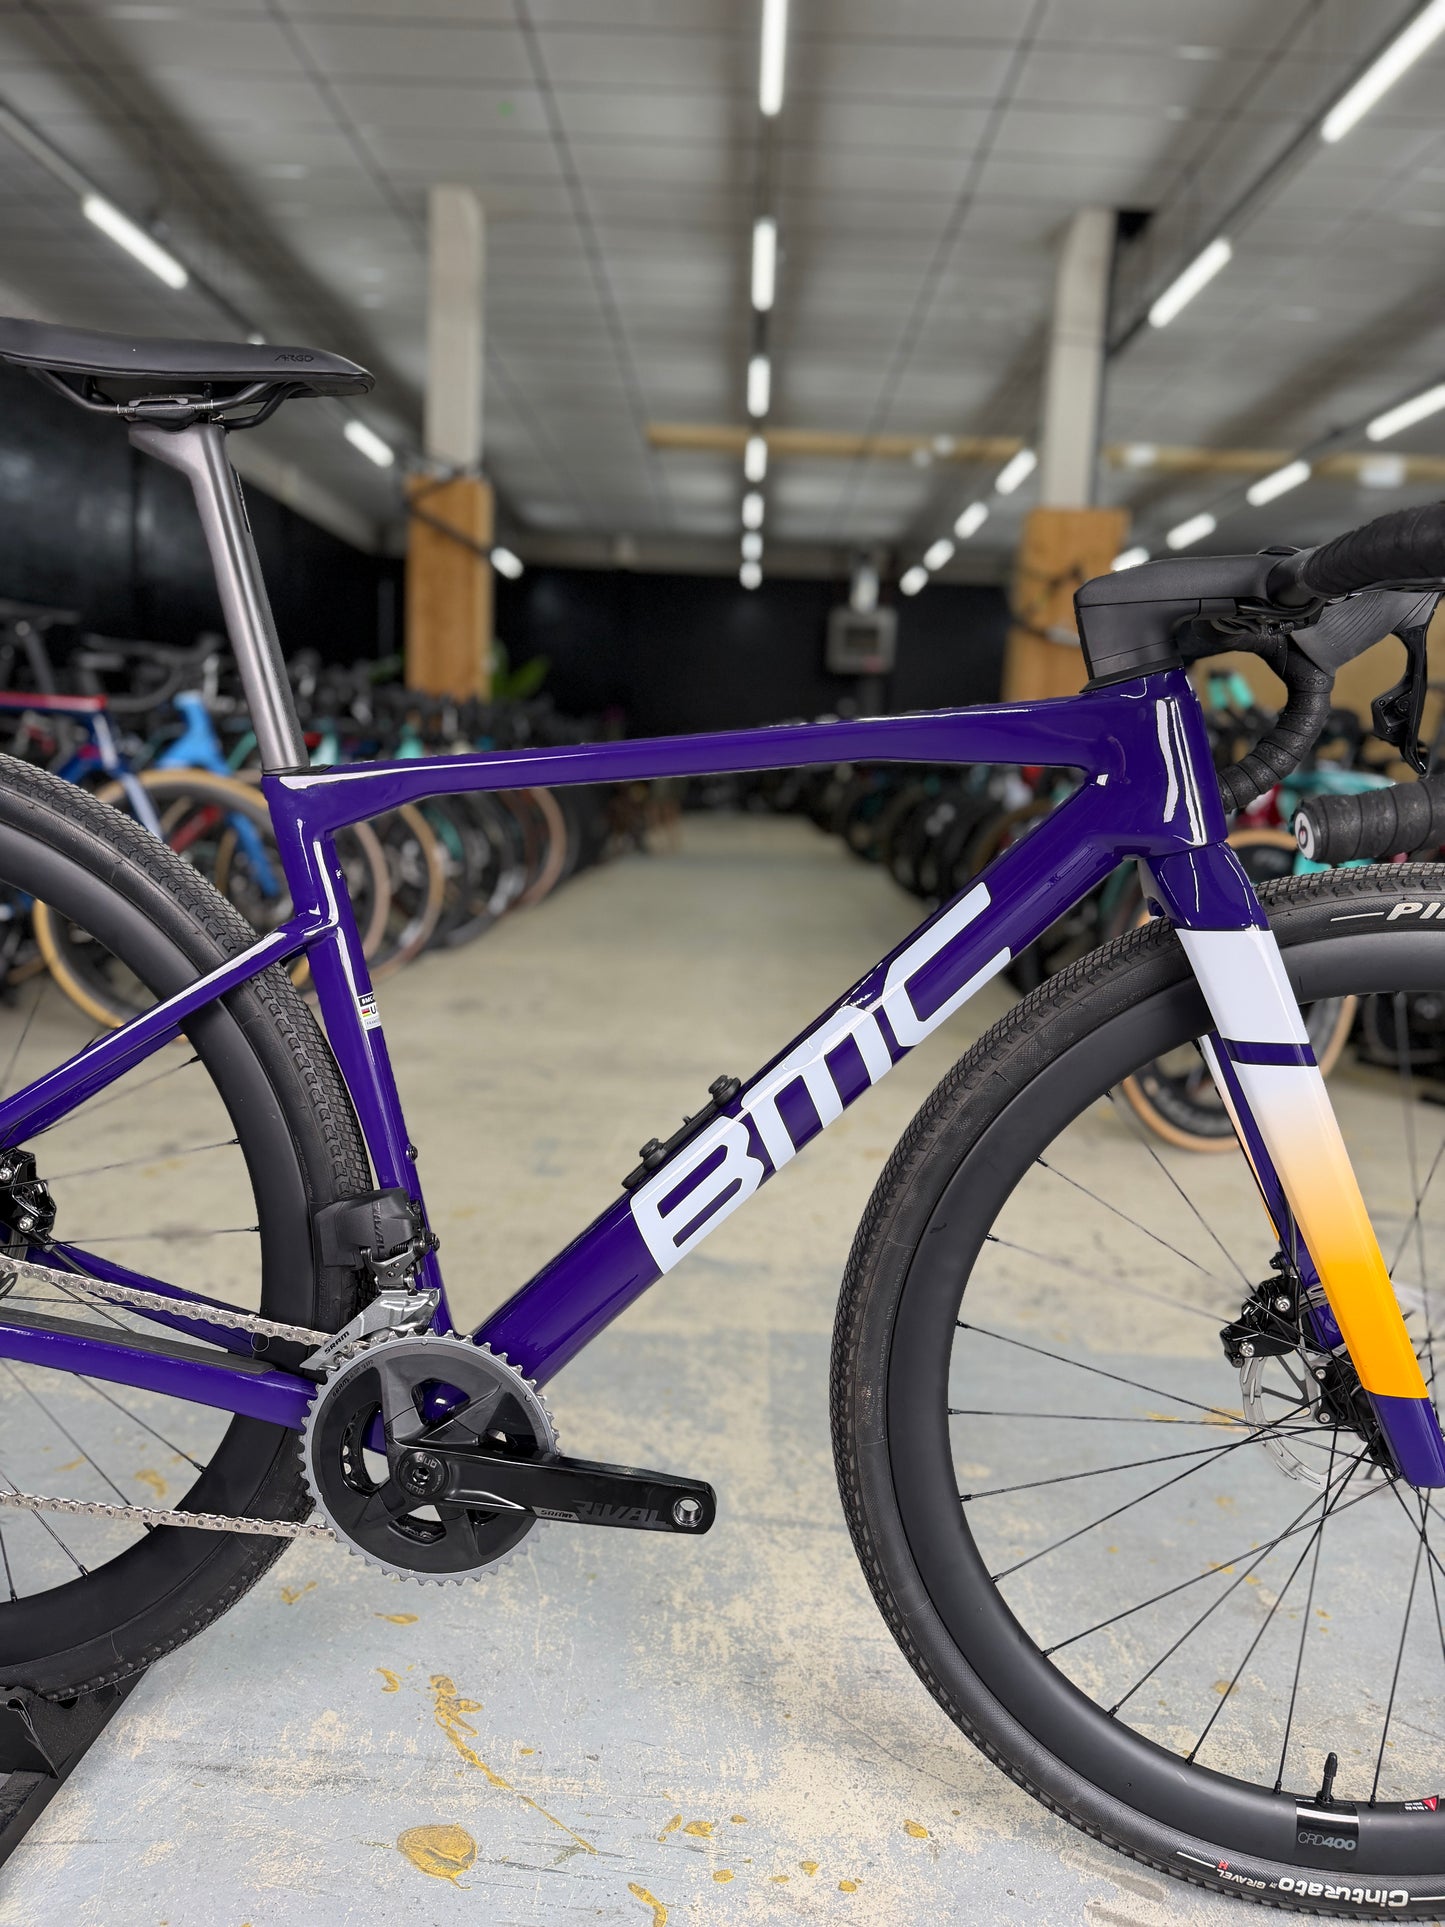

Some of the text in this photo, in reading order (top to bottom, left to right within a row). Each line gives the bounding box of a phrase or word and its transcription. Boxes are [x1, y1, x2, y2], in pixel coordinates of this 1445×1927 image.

[274, 354, 315, 363] ARGO
[630, 882, 1011, 1274] BMC
[324, 1330, 350, 1355] SRAM
[571, 1500, 671, 1528] RIVAL
[1298, 1832, 1357, 1851] CRD400
[1216, 1868, 1266, 1889] GRAVEL
[1278, 1877, 1409, 1907] Cinturato
